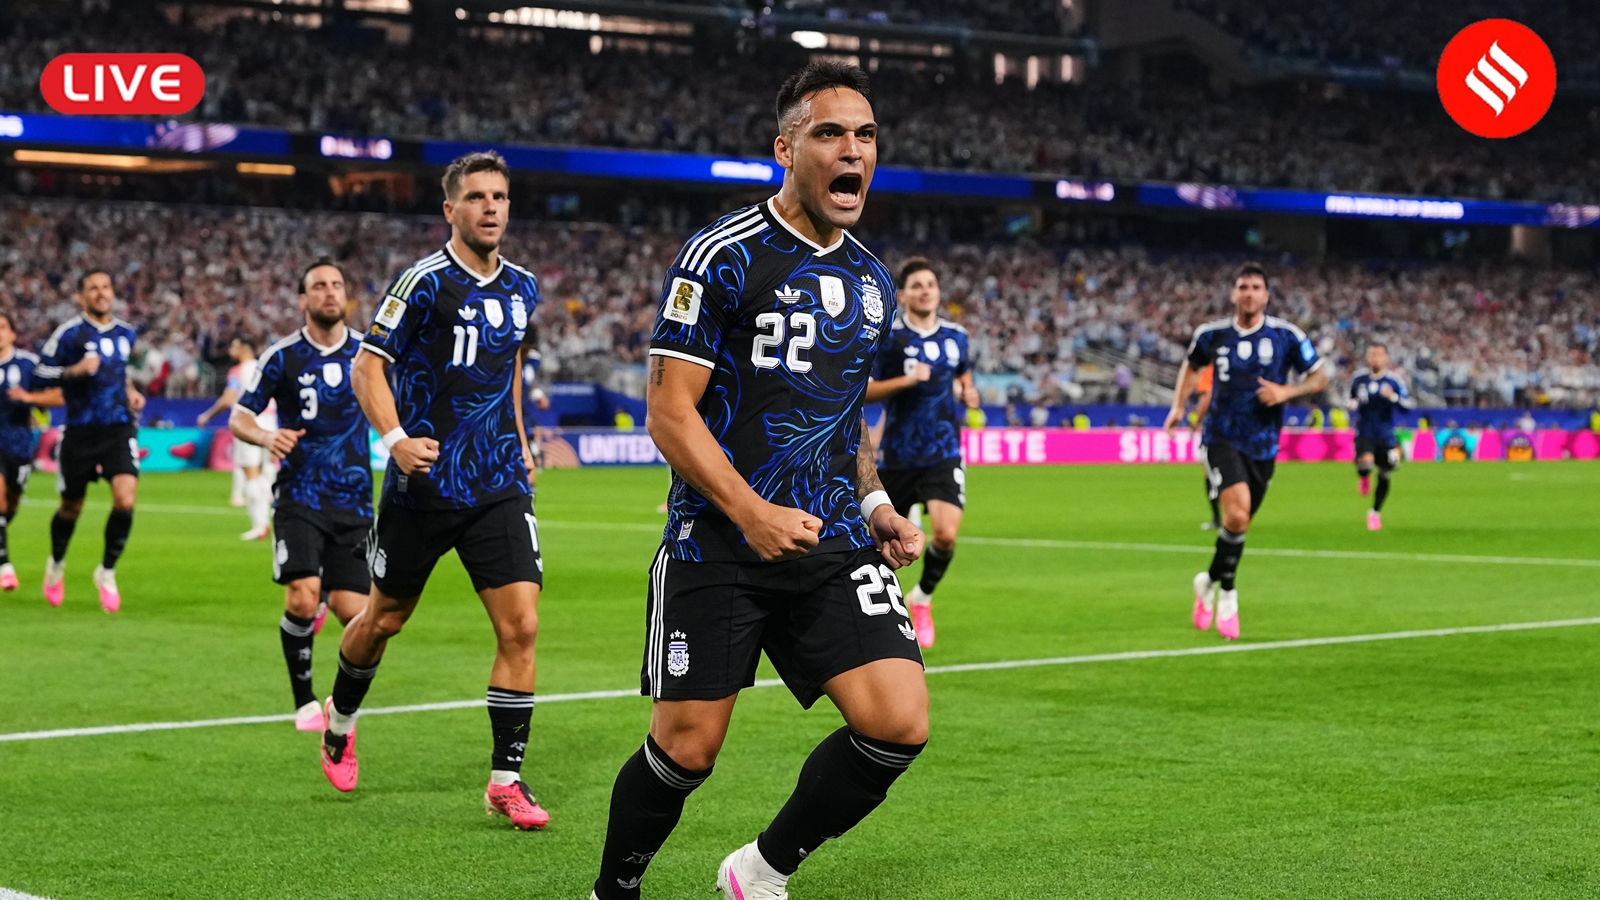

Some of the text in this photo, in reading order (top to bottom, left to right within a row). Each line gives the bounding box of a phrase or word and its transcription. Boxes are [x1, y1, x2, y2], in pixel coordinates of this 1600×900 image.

[452, 325, 478, 367] 11
[750, 312, 816, 373] 22
[1216, 356, 1231, 382] 2
[299, 387, 318, 420] 3
[578, 434, 657, 463] UNITED
[850, 564, 910, 618] 22
